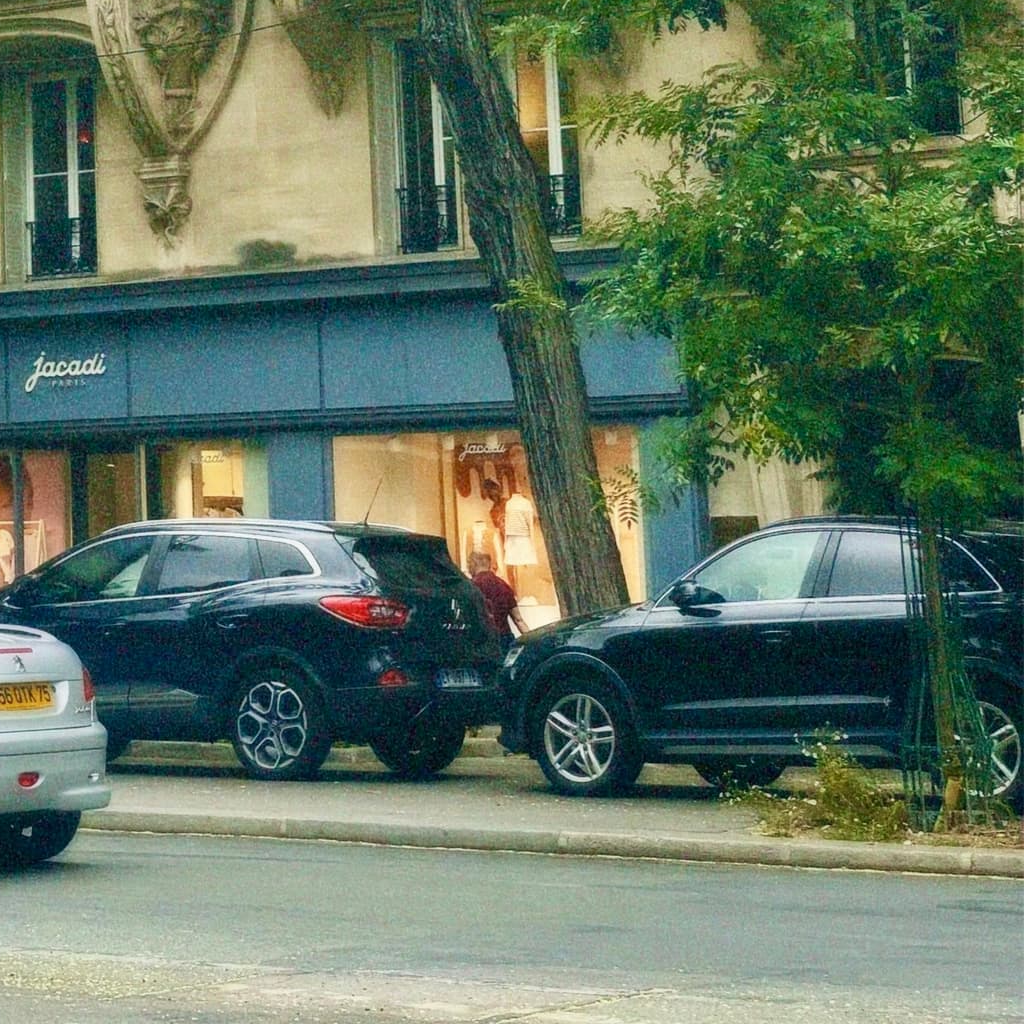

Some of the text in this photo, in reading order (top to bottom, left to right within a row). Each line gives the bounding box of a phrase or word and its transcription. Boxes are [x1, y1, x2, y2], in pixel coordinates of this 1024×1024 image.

[24, 351, 106, 392] jacadi
[51, 379, 87, 387] PARIS
[458, 442, 508, 462] jacadi
[36, 685, 51, 703] 75
